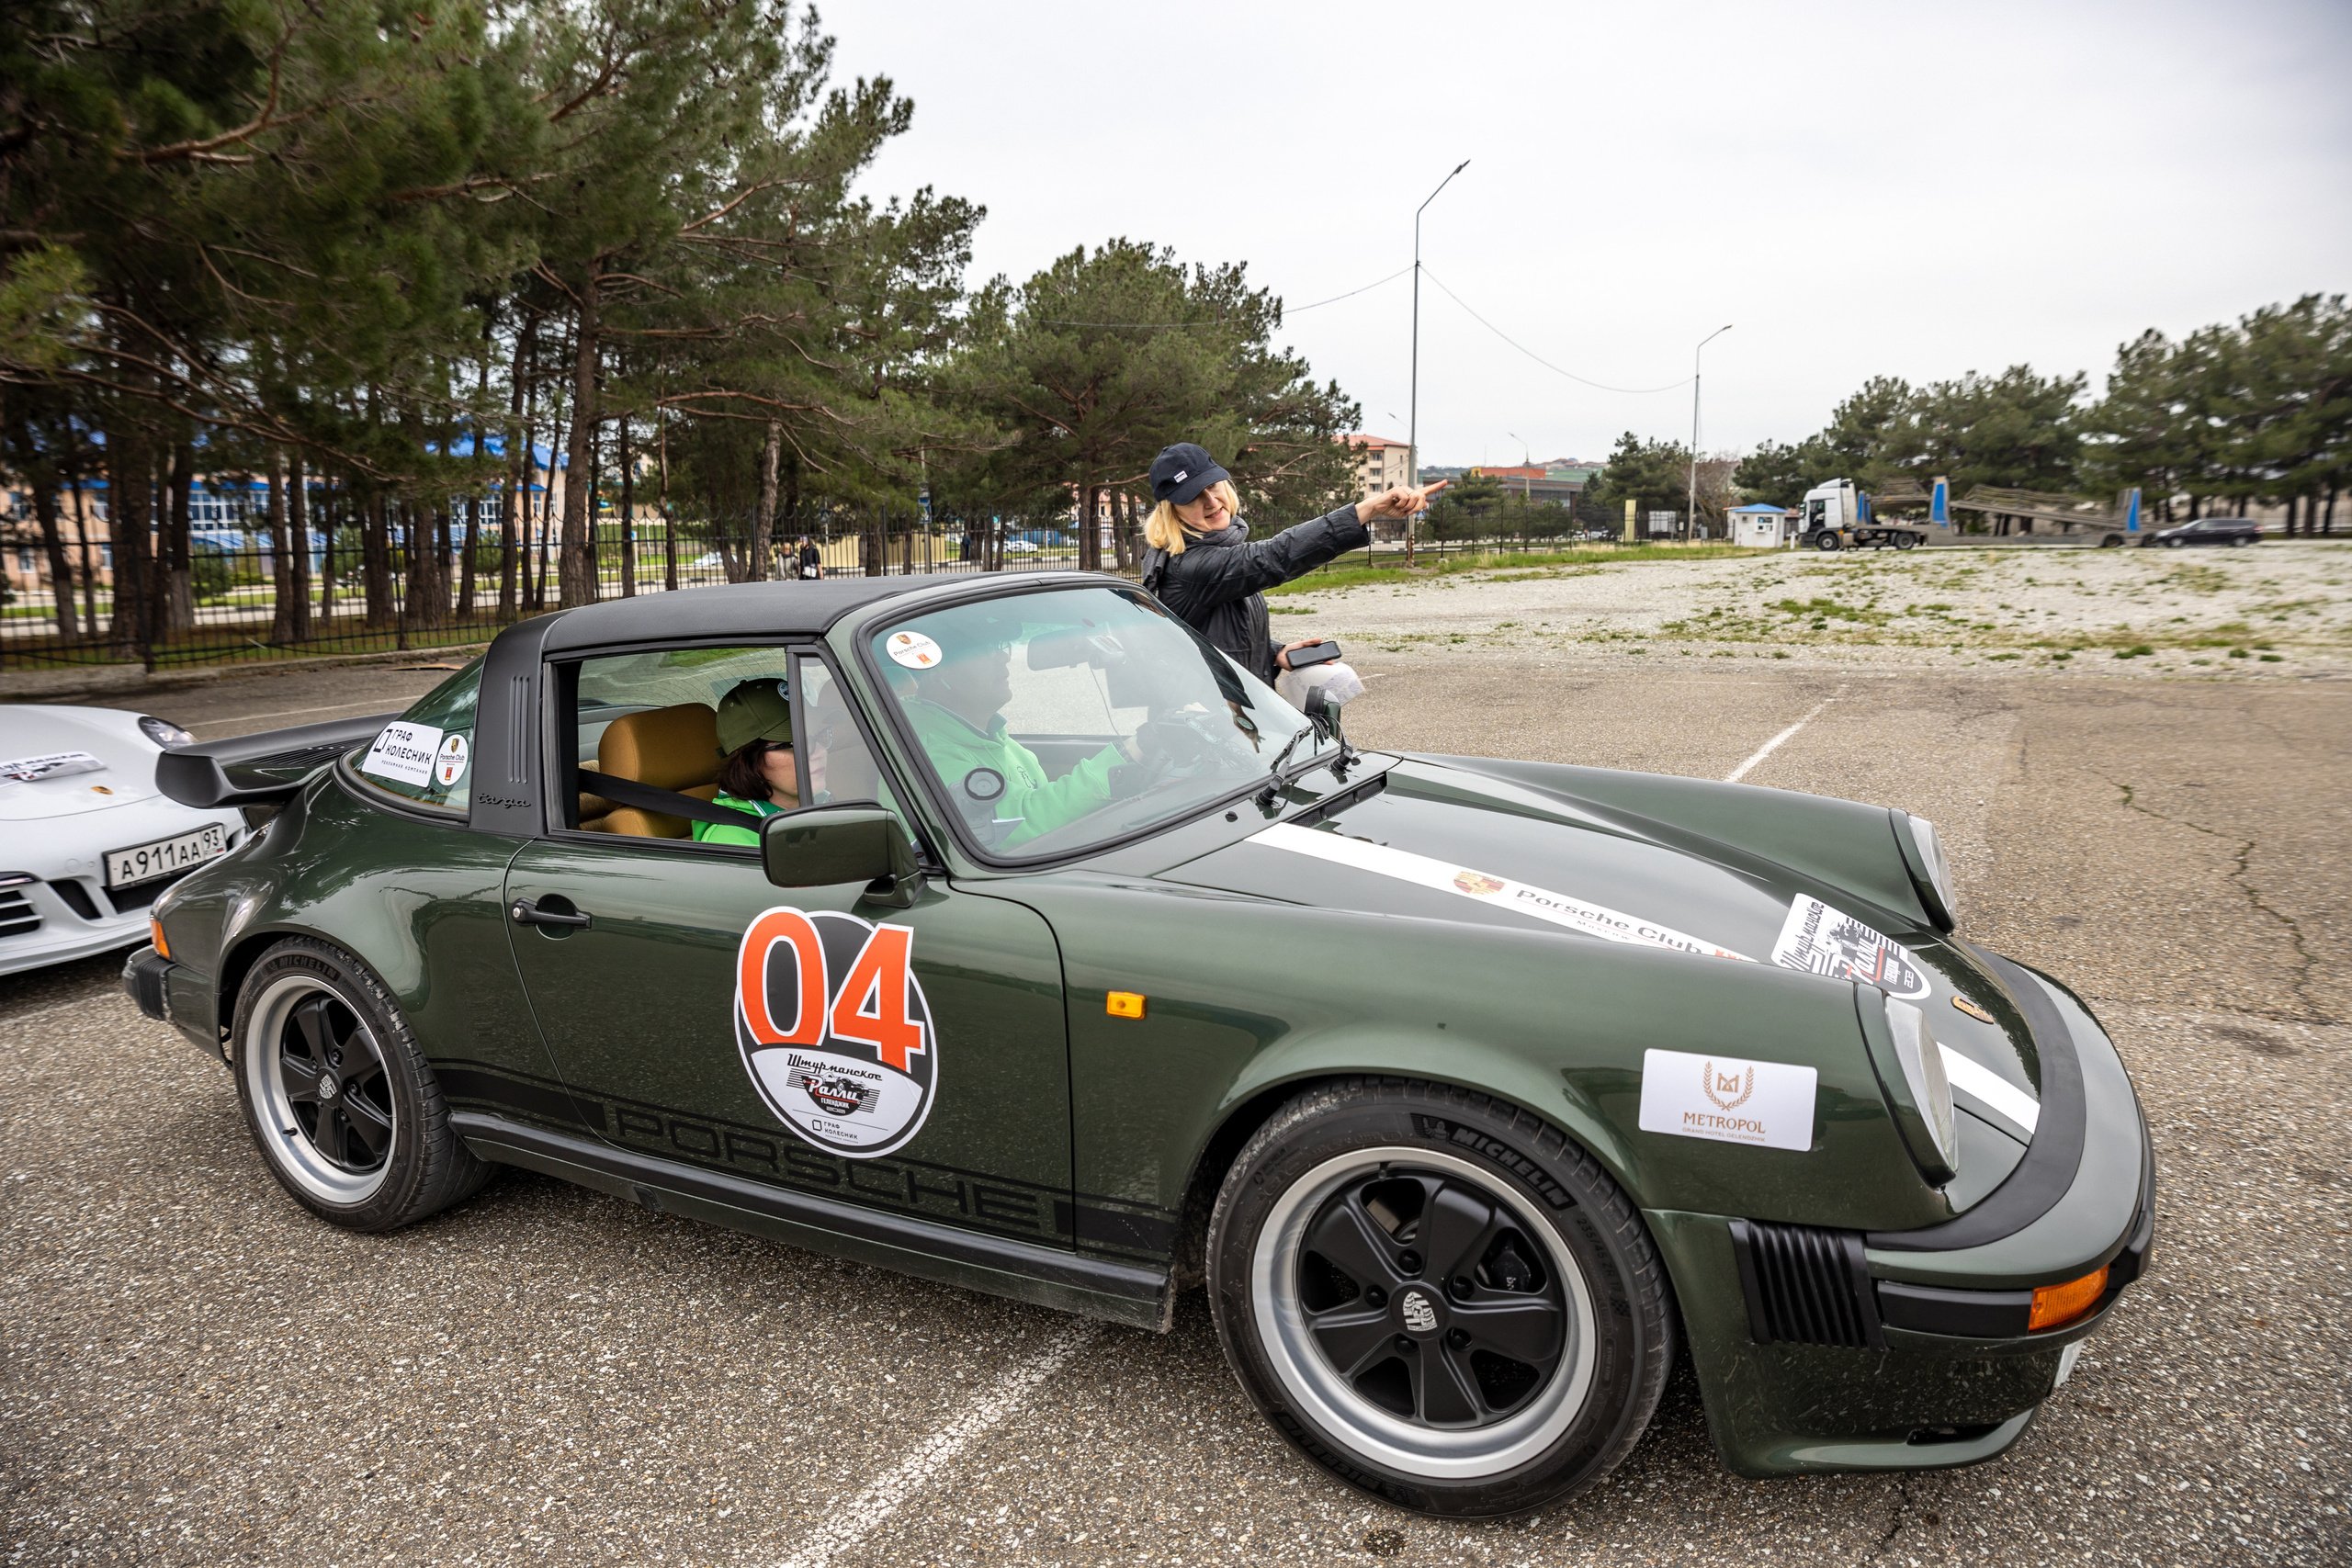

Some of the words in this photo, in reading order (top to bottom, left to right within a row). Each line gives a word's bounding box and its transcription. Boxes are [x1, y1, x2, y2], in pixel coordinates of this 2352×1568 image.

[893, 645, 917, 656] Porsche
[391, 729, 413, 741] ГРАФ
[386, 745, 432, 765] КОЛЕСНИК
[476, 793, 532, 809] targa
[203, 829, 220, 849] 93
[1516, 889, 1631, 931] Porsche
[1637, 927, 1702, 954] Club
[279, 954, 338, 980] MICHELIN
[738, 906, 926, 1074] 04
[786, 1053, 883, 1081] Штурманское
[808, 1076, 859, 1101] Ралли
[823, 1121, 841, 1130] ГРАФ
[824, 1128, 858, 1140] КОЛЕСНИК
[1683, 1111, 1766, 1134] METROPOL
[1682, 1127, 1704, 1135] GRAND
[1705, 1130, 1725, 1138] HOTEL
[1727, 1133, 1766, 1143] GELENDZHIK
[615, 1106, 1041, 1230] PORSCHE
[1451, 1126, 1570, 1206] MICHELIN
[1577, 1217, 1608, 1259] 235/45
